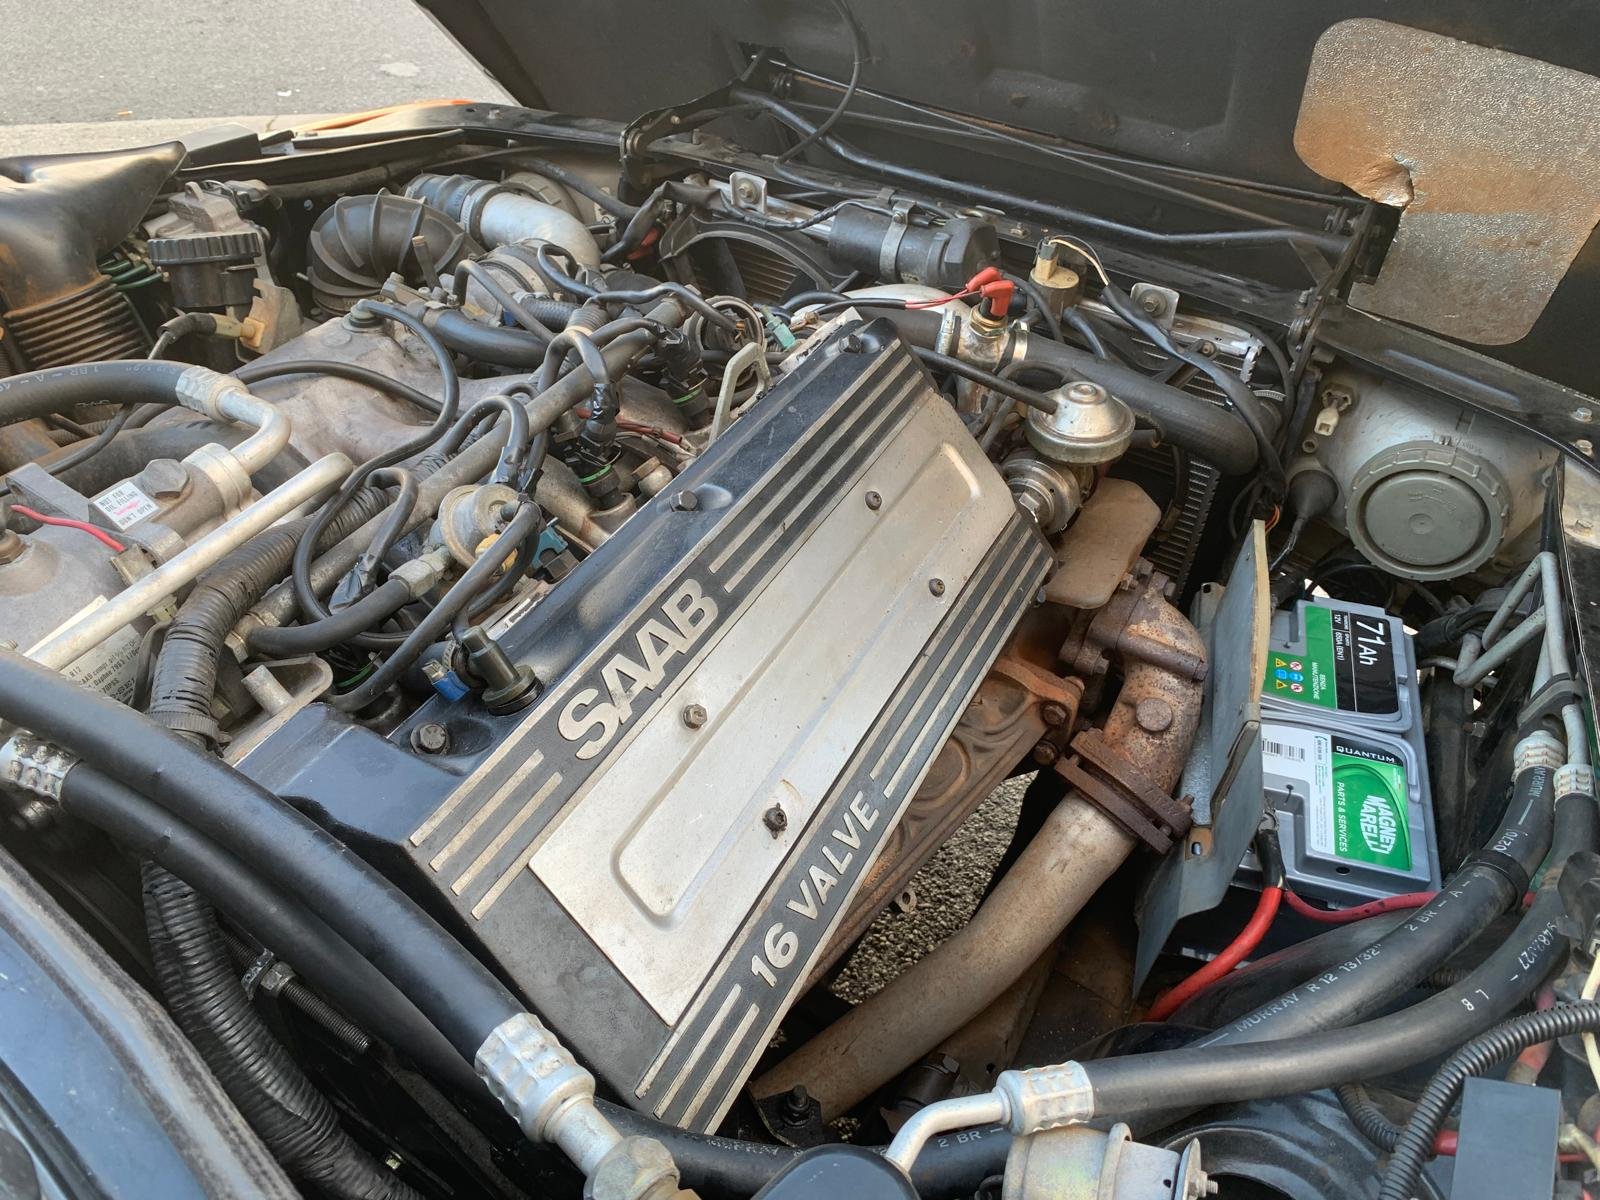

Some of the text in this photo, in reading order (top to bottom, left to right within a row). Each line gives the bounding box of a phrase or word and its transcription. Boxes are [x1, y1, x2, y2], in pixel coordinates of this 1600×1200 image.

[1356, 620, 1386, 666] 71Ah
[557, 578, 719, 761] SAAB
[1335, 745, 1396, 764] QUANTUM
[1336, 781, 1346, 806] PARTS
[1527, 766, 1548, 798] MURRAY
[1338, 814, 1349, 853] SERVICES
[1359, 795, 1384, 854] MARELLI
[1372, 796, 1397, 855] MAGNETI
[751, 790, 880, 988] 16 VALVE
[1235, 992, 1300, 1033] MURRAY
[1306, 983, 1320, 994] R
[1318, 972, 1339, 986] 12
[1415, 910, 1438, 924] BR
[938, 1129, 982, 1148] 2 BR
